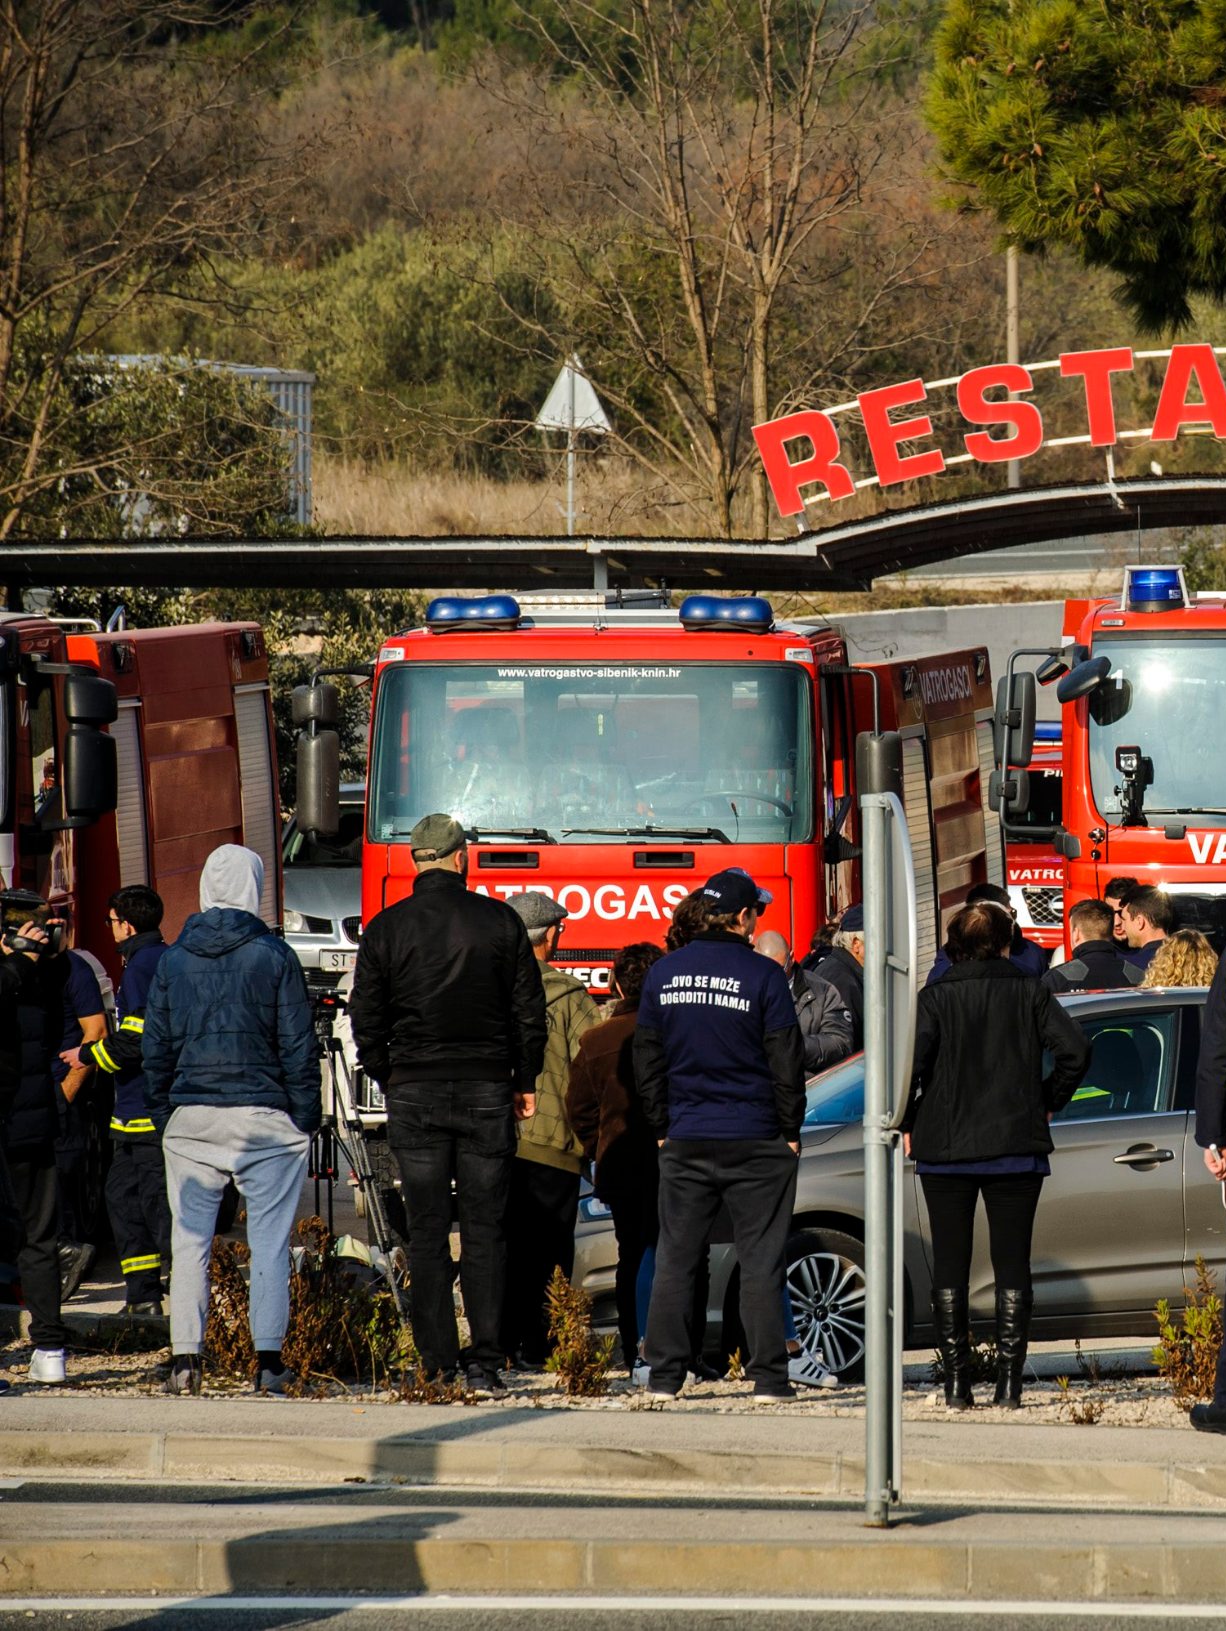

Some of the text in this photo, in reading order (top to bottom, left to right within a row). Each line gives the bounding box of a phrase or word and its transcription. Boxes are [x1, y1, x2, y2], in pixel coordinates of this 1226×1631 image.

[498, 668, 681, 679] www.vatrogastvo-sibenik-knin.hr
[1110, 668, 1124, 690] 1
[919, 665, 973, 705] VATROGASCI
[331, 953, 347, 967] ST
[694, 975, 709, 988] SE
[710, 976, 741, 993] MOŽE
[660, 991, 751, 1012] DOGODITI I NAMA!
